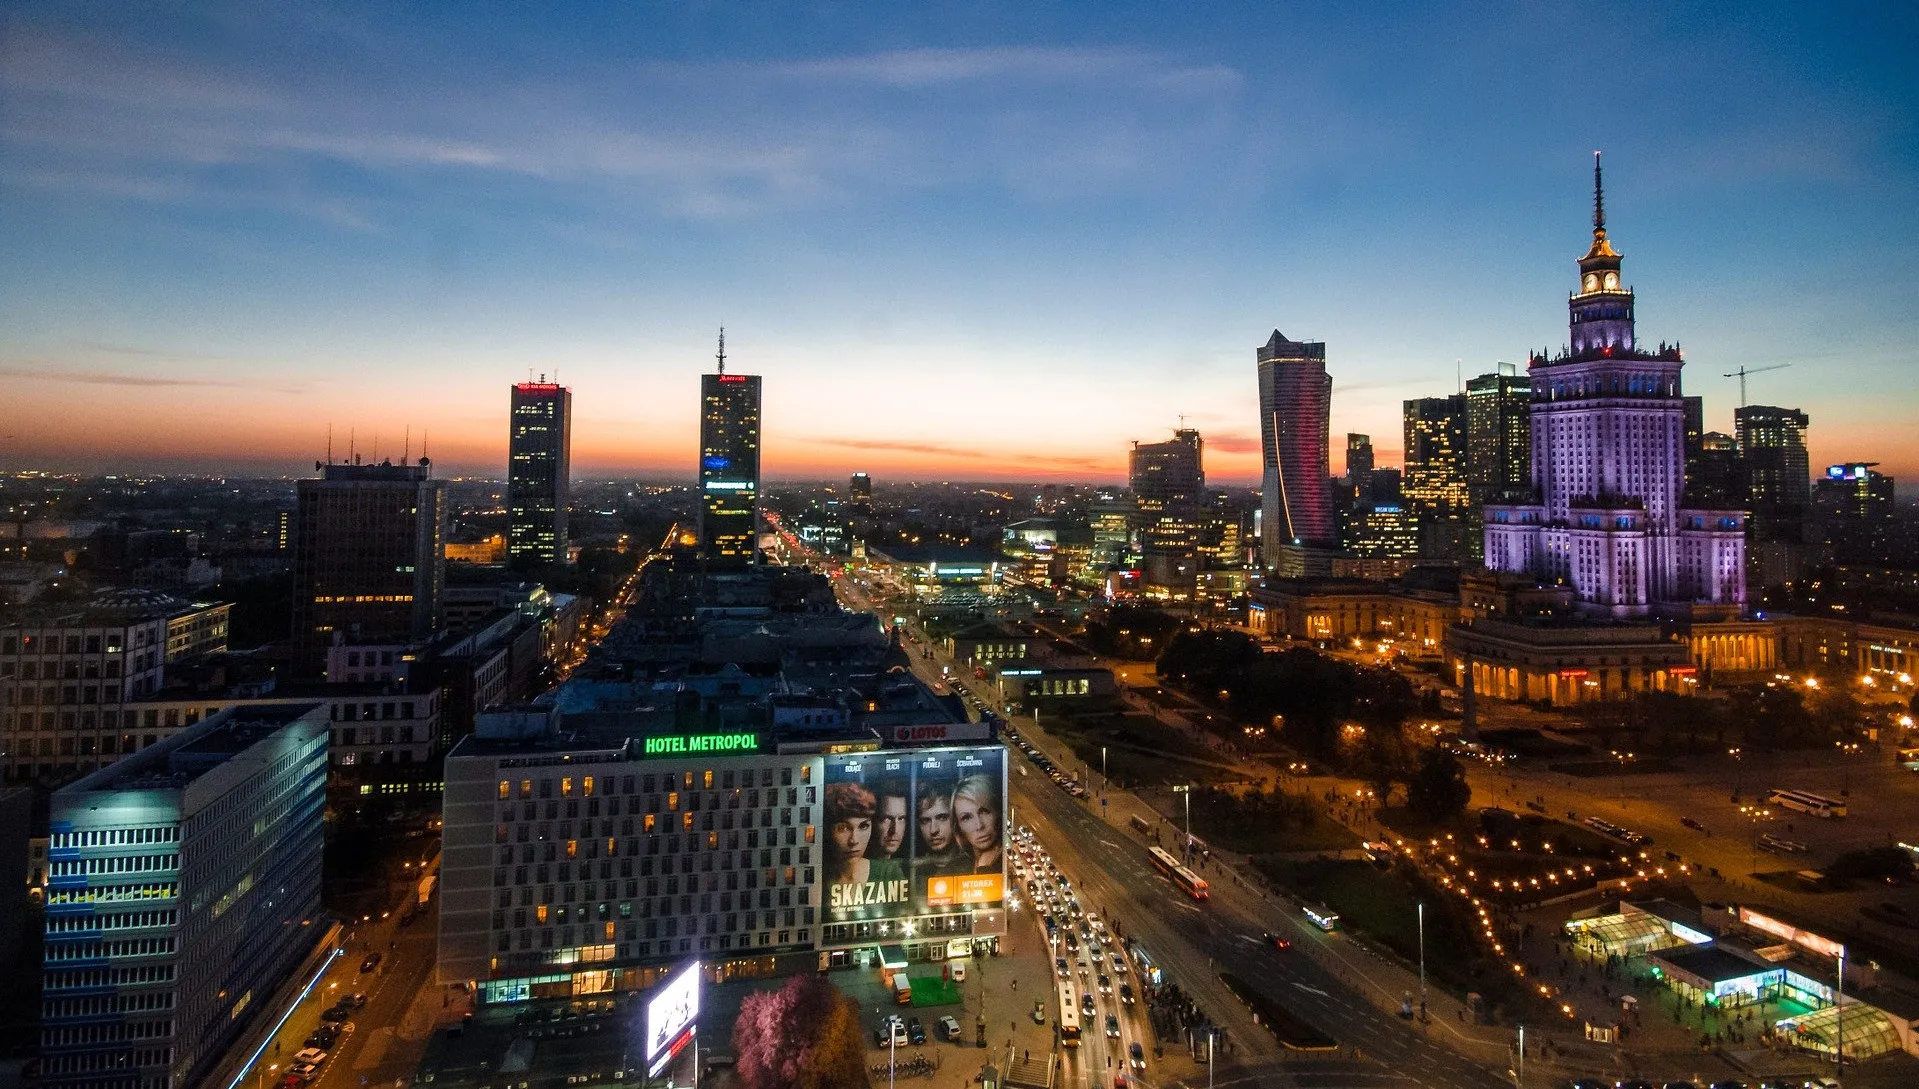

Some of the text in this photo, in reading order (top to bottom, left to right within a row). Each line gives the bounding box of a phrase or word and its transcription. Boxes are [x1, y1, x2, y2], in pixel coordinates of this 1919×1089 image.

[911, 727, 947, 740] LOTOS
[646, 734, 757, 753] HOTEL METROPOL
[831, 879, 909, 907] SKAZANE
